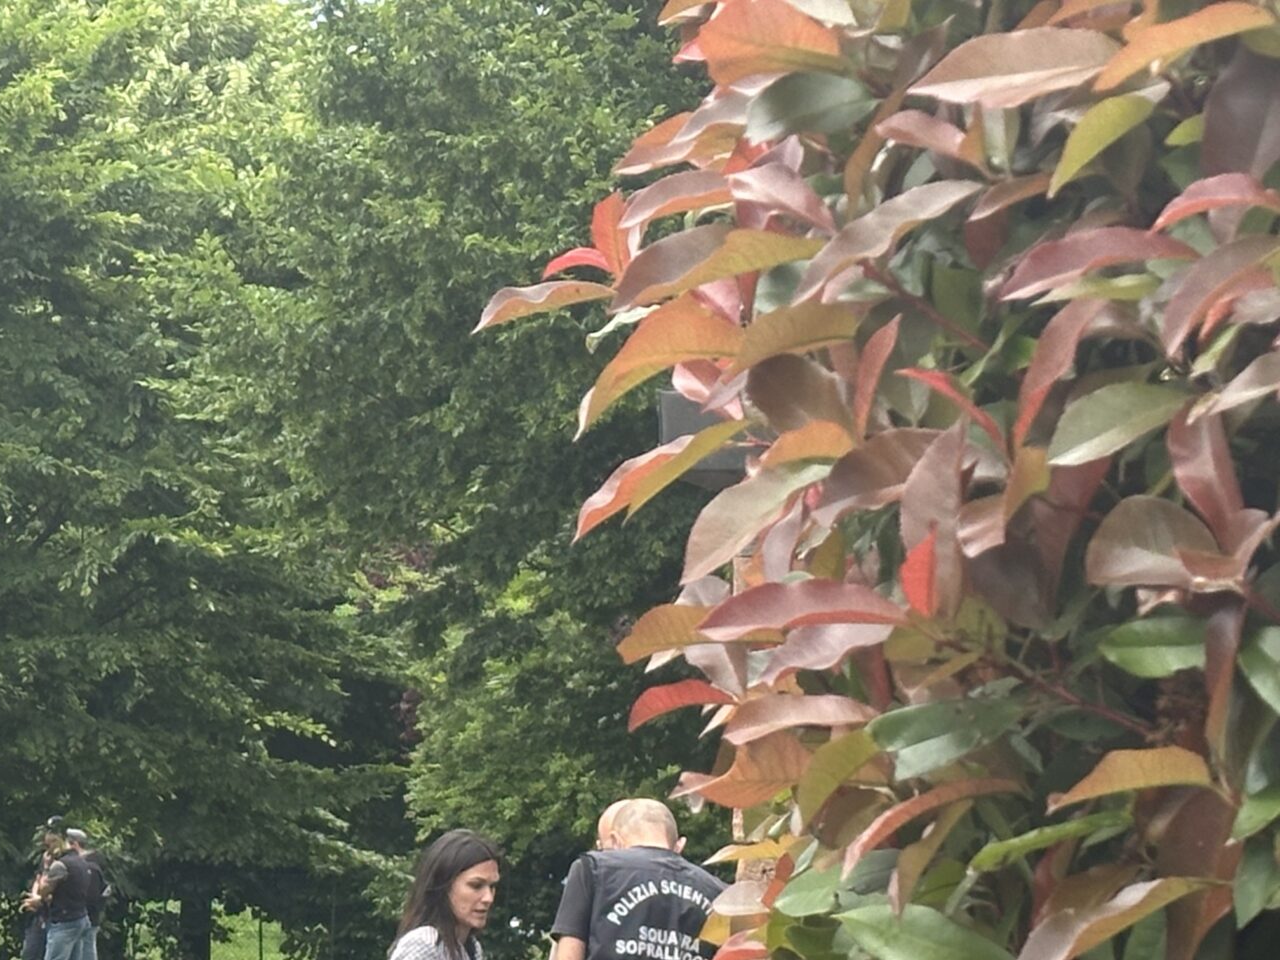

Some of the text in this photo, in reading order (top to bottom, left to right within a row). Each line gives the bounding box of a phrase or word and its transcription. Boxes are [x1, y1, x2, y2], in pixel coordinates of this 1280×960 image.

[606, 879, 714, 926] POLIZIA SCIENTI
[638, 925, 700, 954] SQUARA
